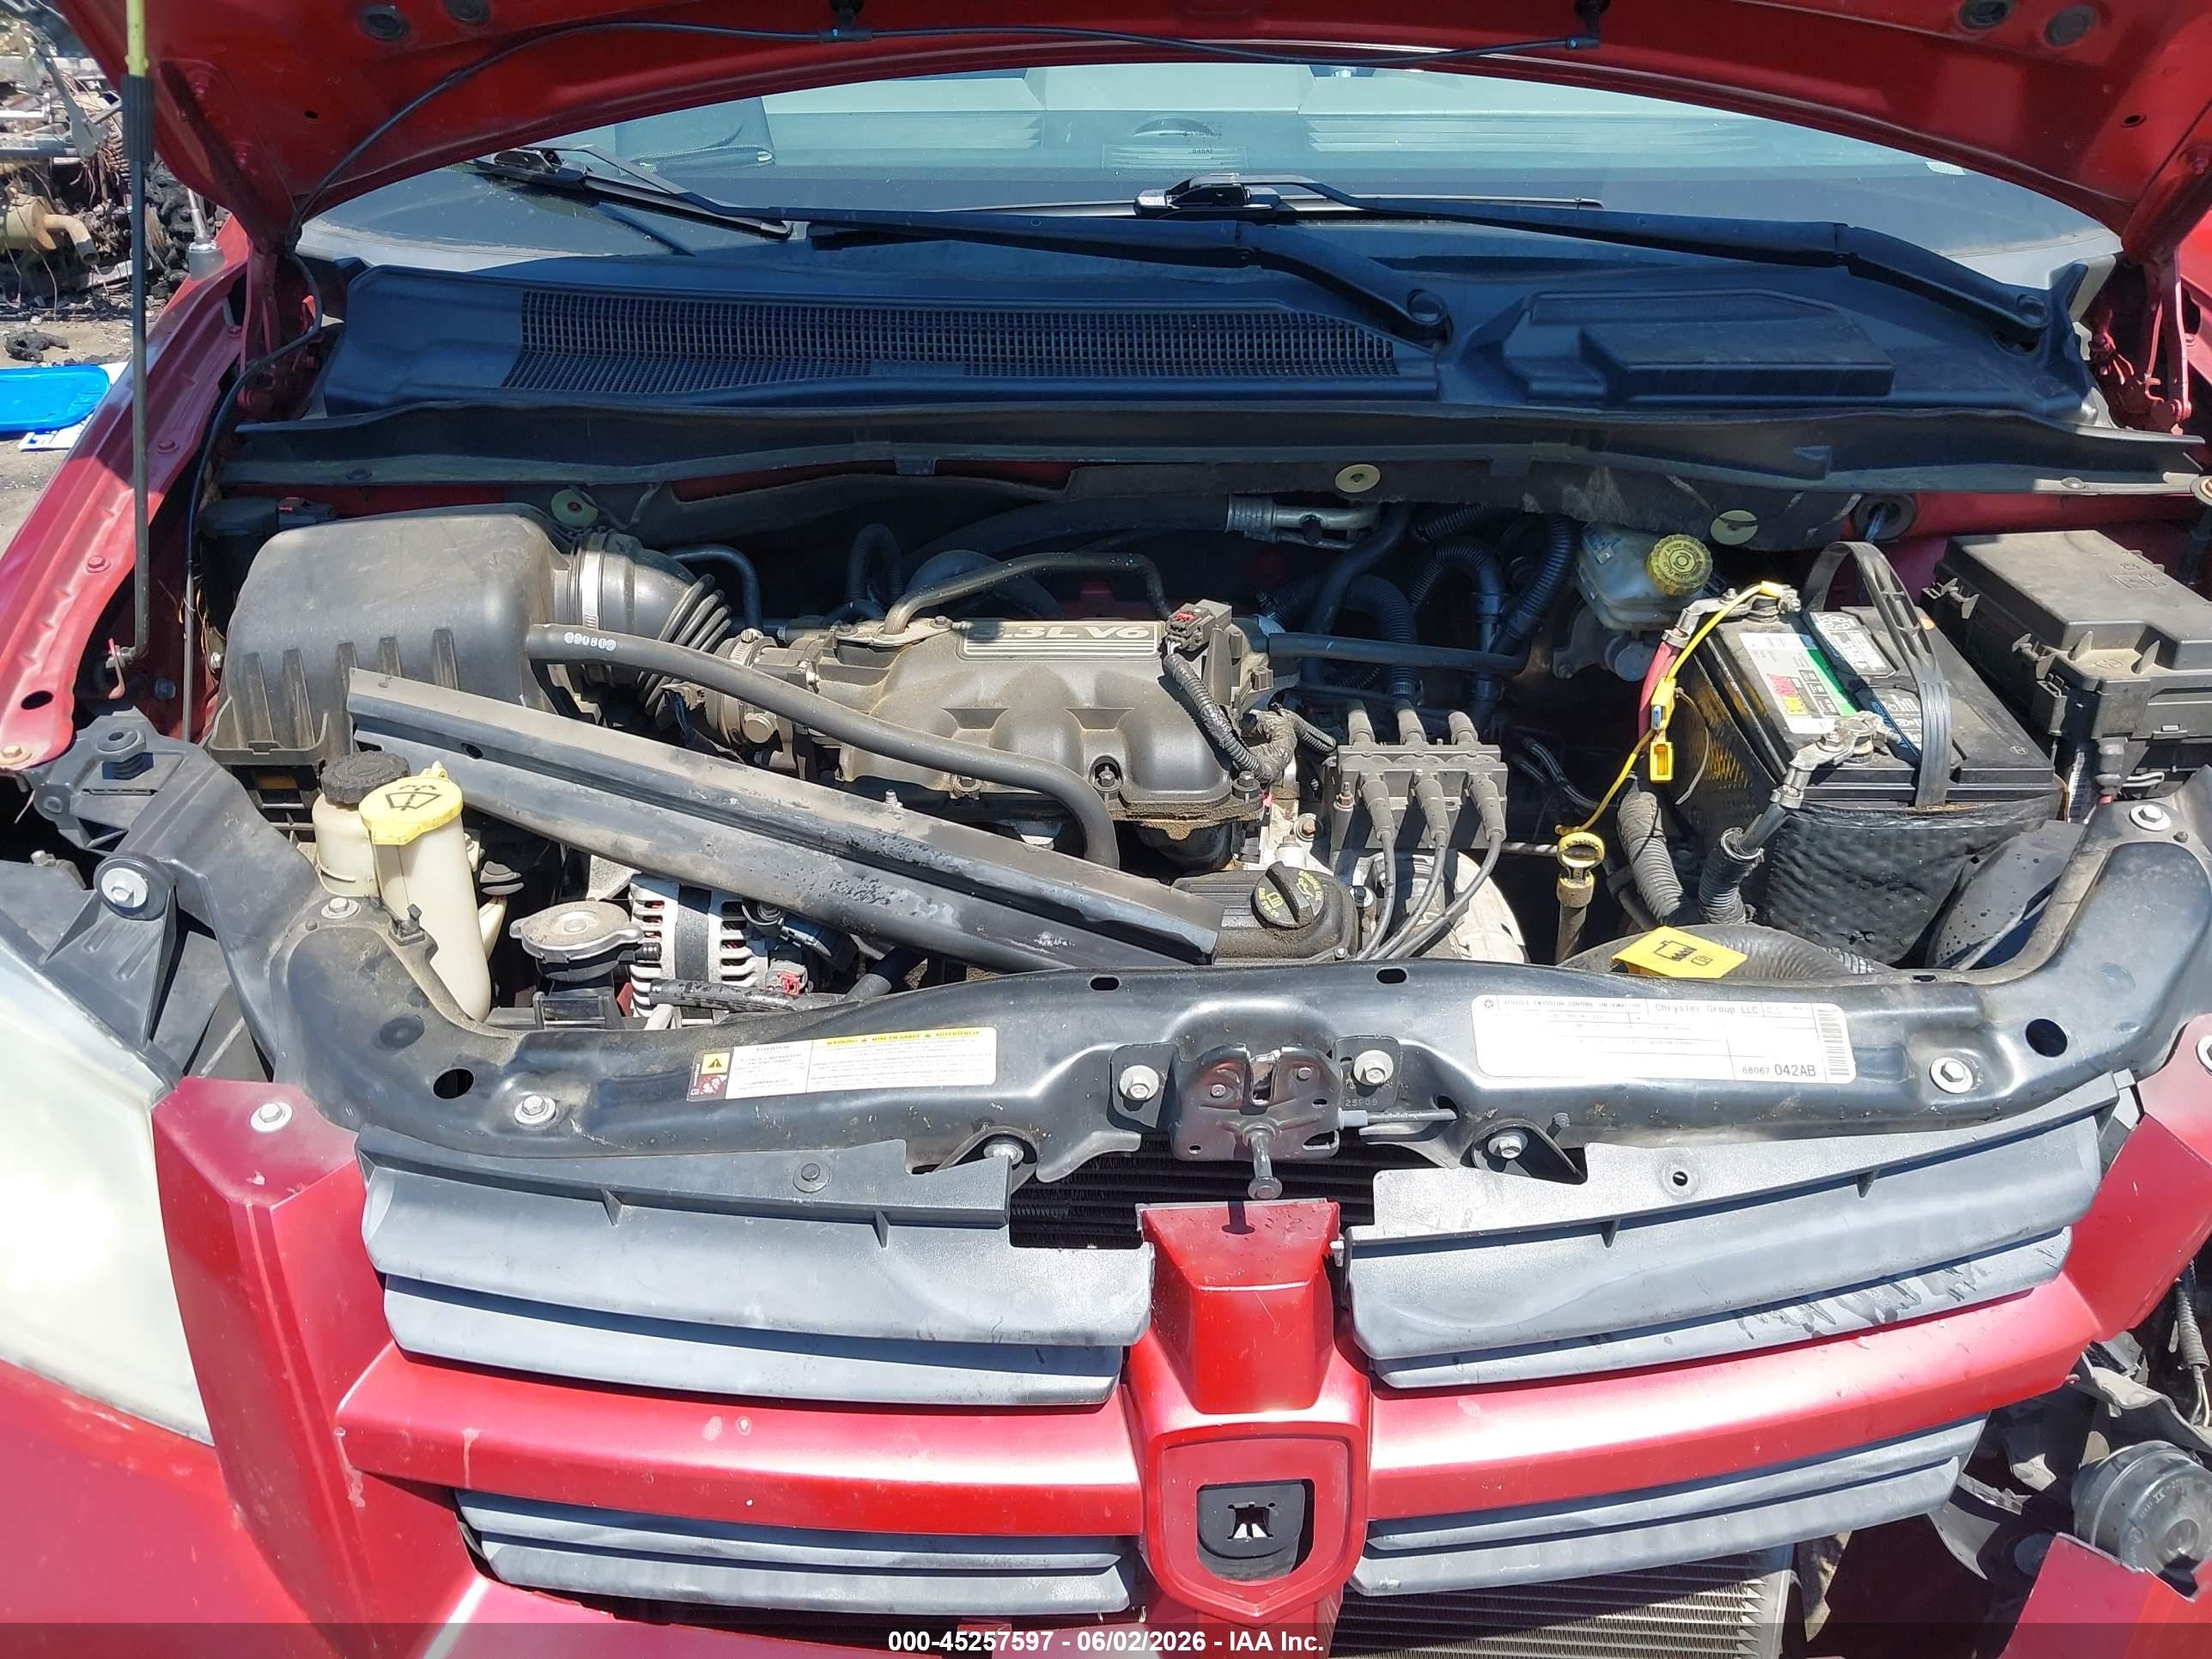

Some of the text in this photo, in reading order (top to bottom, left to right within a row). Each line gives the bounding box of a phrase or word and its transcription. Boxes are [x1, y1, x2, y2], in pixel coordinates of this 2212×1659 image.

[1085, 626, 1150, 638] V6
[1297, 870, 1321, 891] ENGINE
[1655, 1003, 1700, 1015] Chrysler
[1706, 1005, 1736, 1016] Group
[1741, 1006, 1759, 1014] LLC
[1774, 1063, 1816, 1076] 042AB
